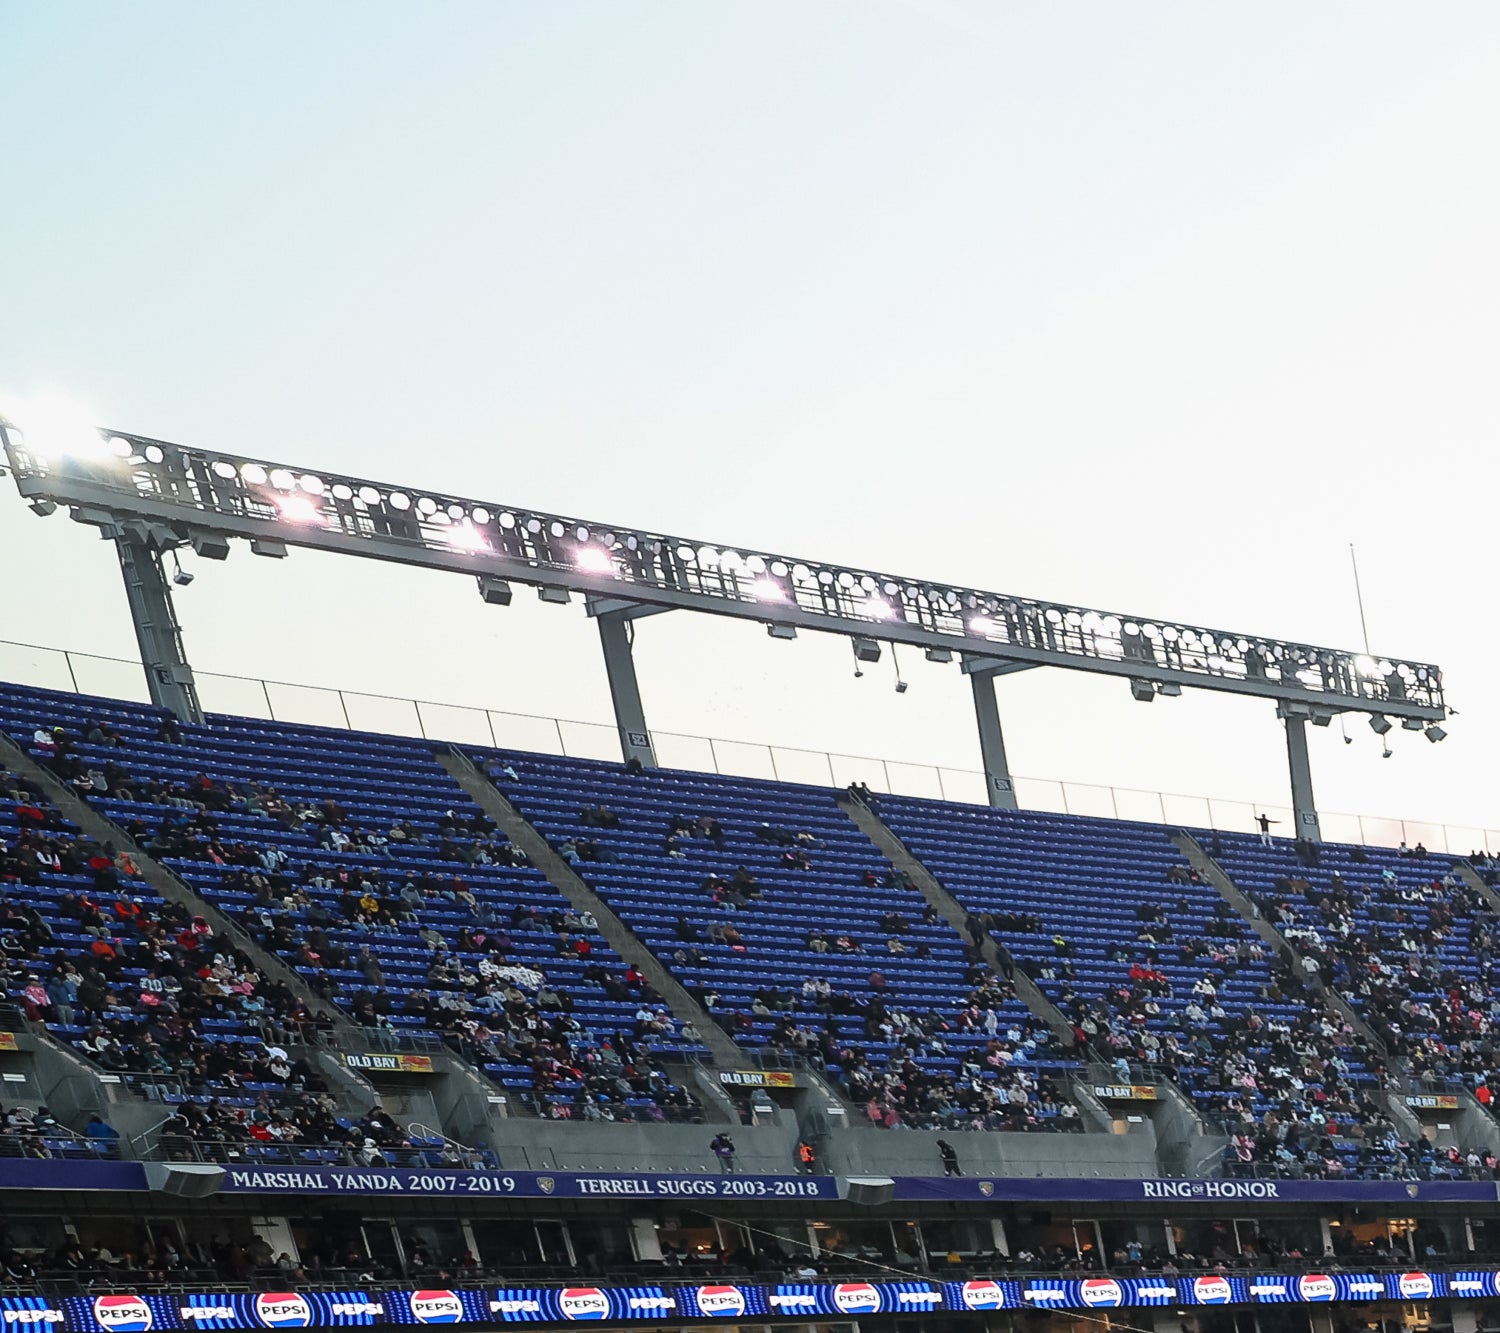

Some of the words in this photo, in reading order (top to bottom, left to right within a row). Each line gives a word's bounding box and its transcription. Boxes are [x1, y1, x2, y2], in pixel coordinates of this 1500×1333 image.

[347, 1055, 370, 1067] OLD
[374, 1056, 396, 1068] BAY
[721, 1072, 741, 1084] OLD
[744, 1073, 763, 1084] BAY
[1095, 1086, 1113, 1096] OLD
[1115, 1087, 1131, 1096] BAY
[232, 1172, 328, 1190] MARSHAL
[331, 1175, 404, 1191] YANDA
[409, 1176, 516, 1192] 2007-2019
[577, 1179, 655, 1196] TERRELL
[658, 1180, 717, 1196] SUGGS
[721, 1181, 821, 1197] 2003-2018
[1144, 1183, 1192, 1198] RING
[1206, 1183, 1280, 1198] HONOR
[415, 1302, 459, 1311] PEPSI
[490, 1300, 540, 1313] PEPSI
[564, 1300, 605, 1309] PEPSI
[702, 1297, 740, 1305] PEPSI
[100, 1308, 148, 1319] PEPSI
[181, 1307, 235, 1320] PEPSI
[262, 1305, 306, 1315] PEPSI
[333, 1302, 384, 1316] PEPSI
[4, 1309, 65, 1323] PEPSI
